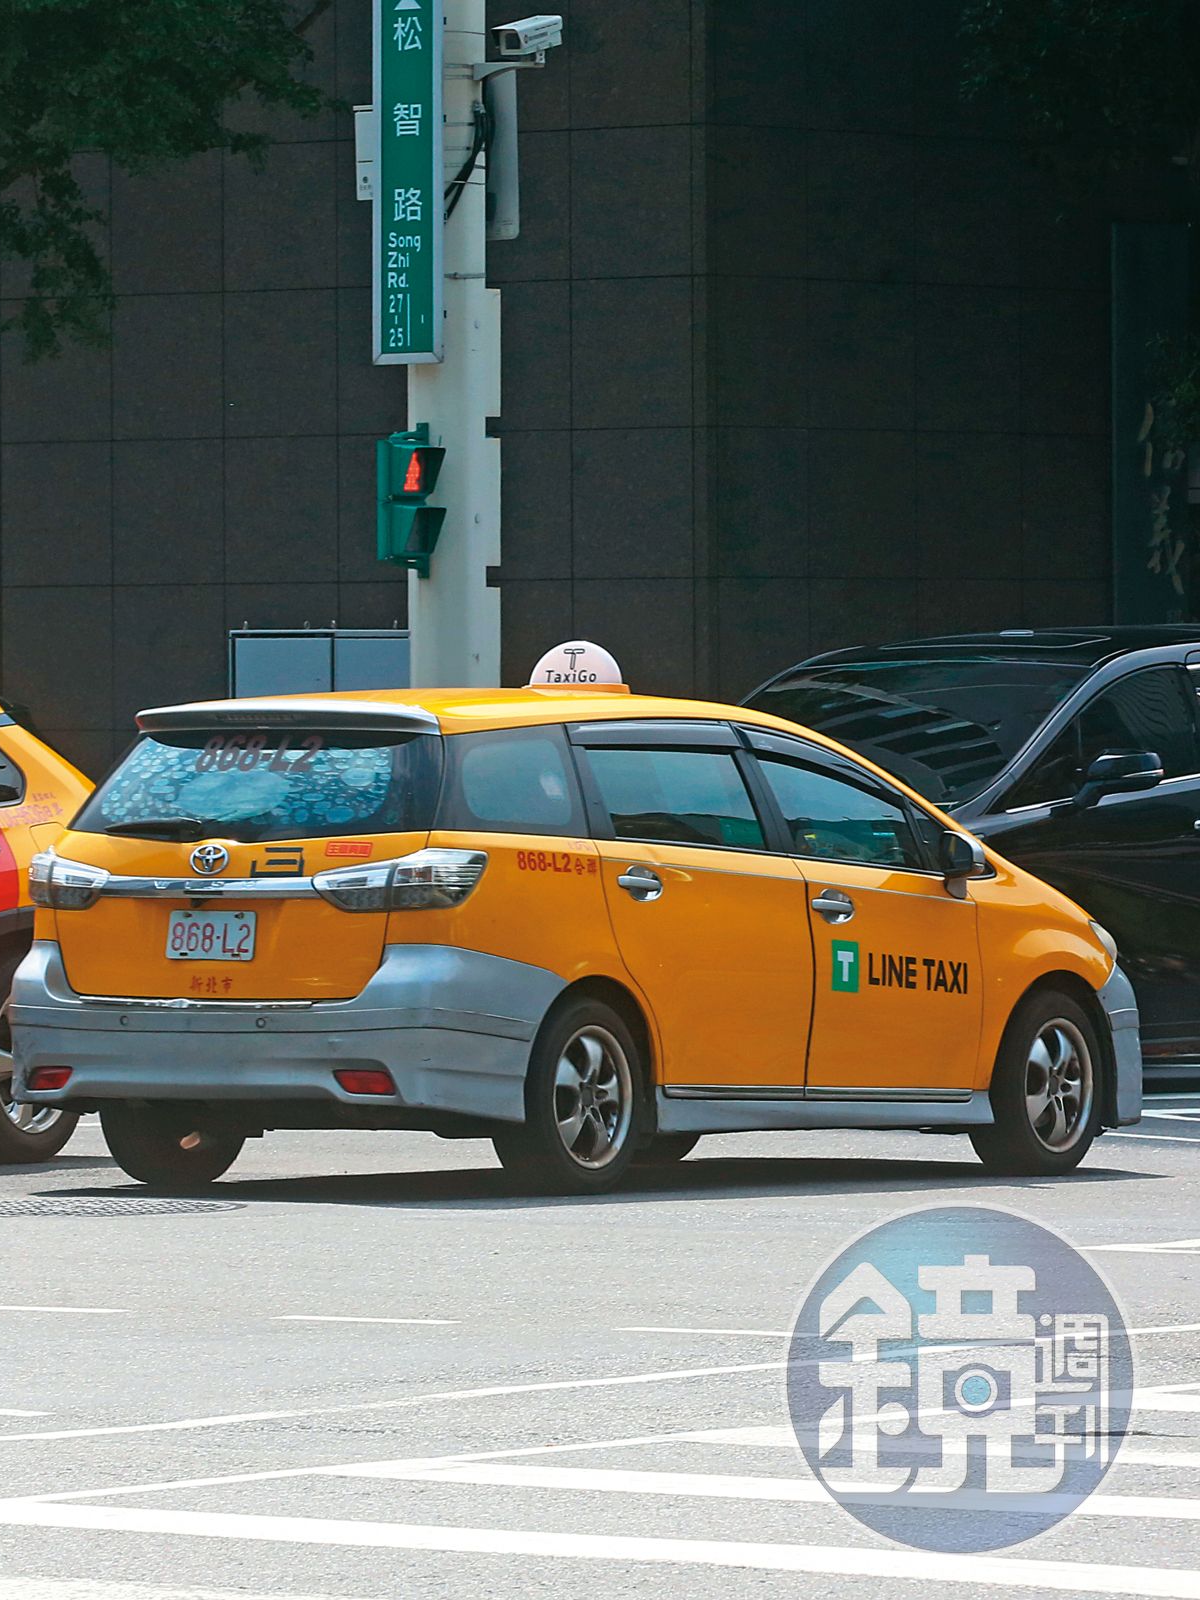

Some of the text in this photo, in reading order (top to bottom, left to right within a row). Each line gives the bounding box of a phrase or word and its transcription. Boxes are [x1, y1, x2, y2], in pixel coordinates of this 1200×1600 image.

[393, 16, 423, 221] 松智路
[388, 232, 421, 252] Song
[387, 252, 410, 268] Zhi
[387, 272, 409, 288] Rd.
[389, 294, 404, 313] 27
[389, 328, 404, 347] 25
[545, 669, 597, 683] TaxiGo
[195, 735, 324, 772] 868-L2
[517, 851, 572, 873] 868-L2
[868, 953, 917, 989] LINE
[922, 958, 968, 994] TAXI
[190, 976, 233, 993] 新北市
